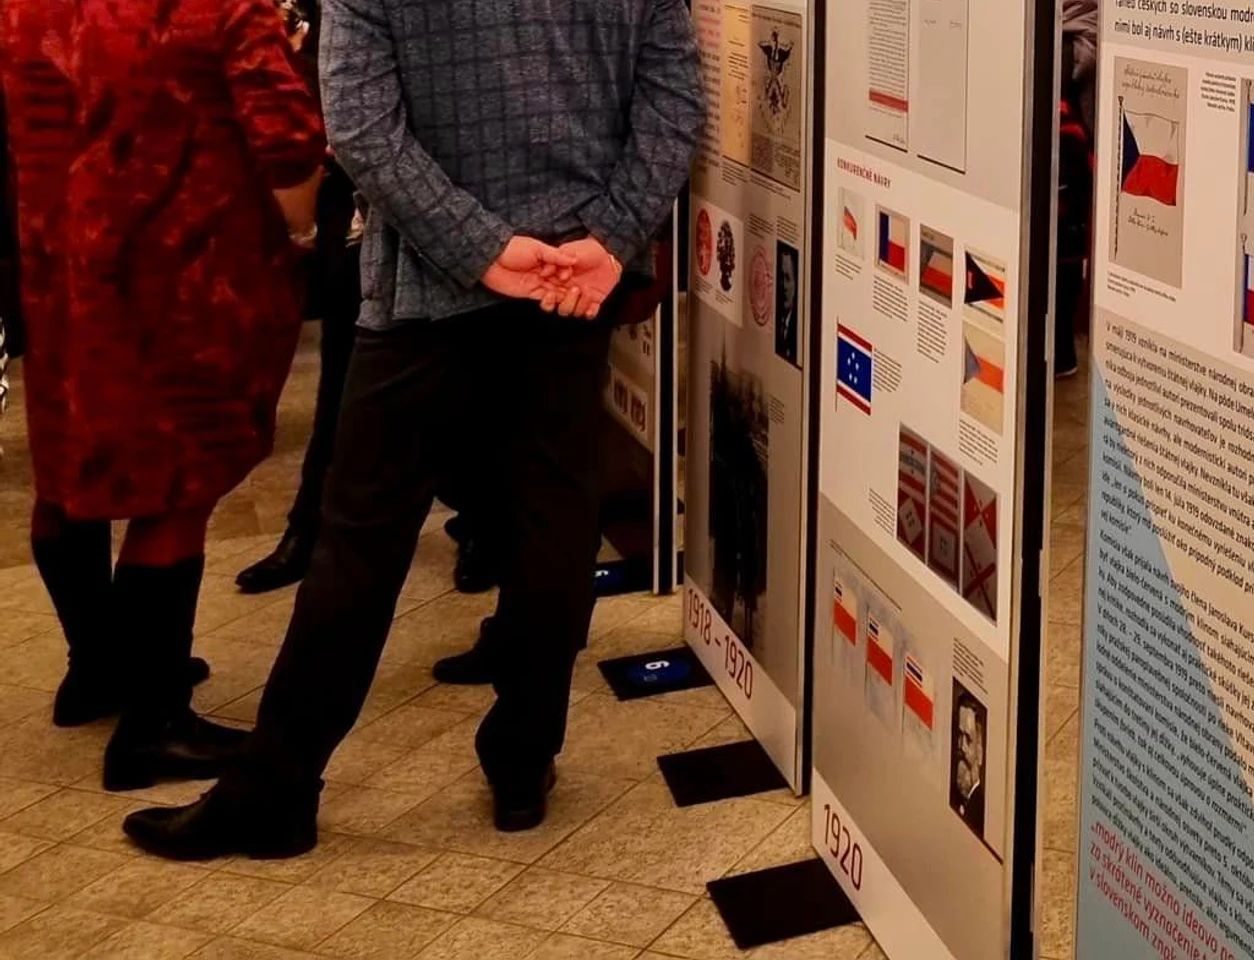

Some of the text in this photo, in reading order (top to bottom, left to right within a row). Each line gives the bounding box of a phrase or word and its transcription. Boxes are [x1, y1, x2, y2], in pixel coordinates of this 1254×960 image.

[1182, 1, 1227, 19] slovenskou
[689, 588, 712, 645] 1918
[725, 635, 752, 700] 1920
[824, 803, 862, 890] 1920
[1145, 869, 1180, 915] možno
[1182, 905, 1217, 953] ideovo
